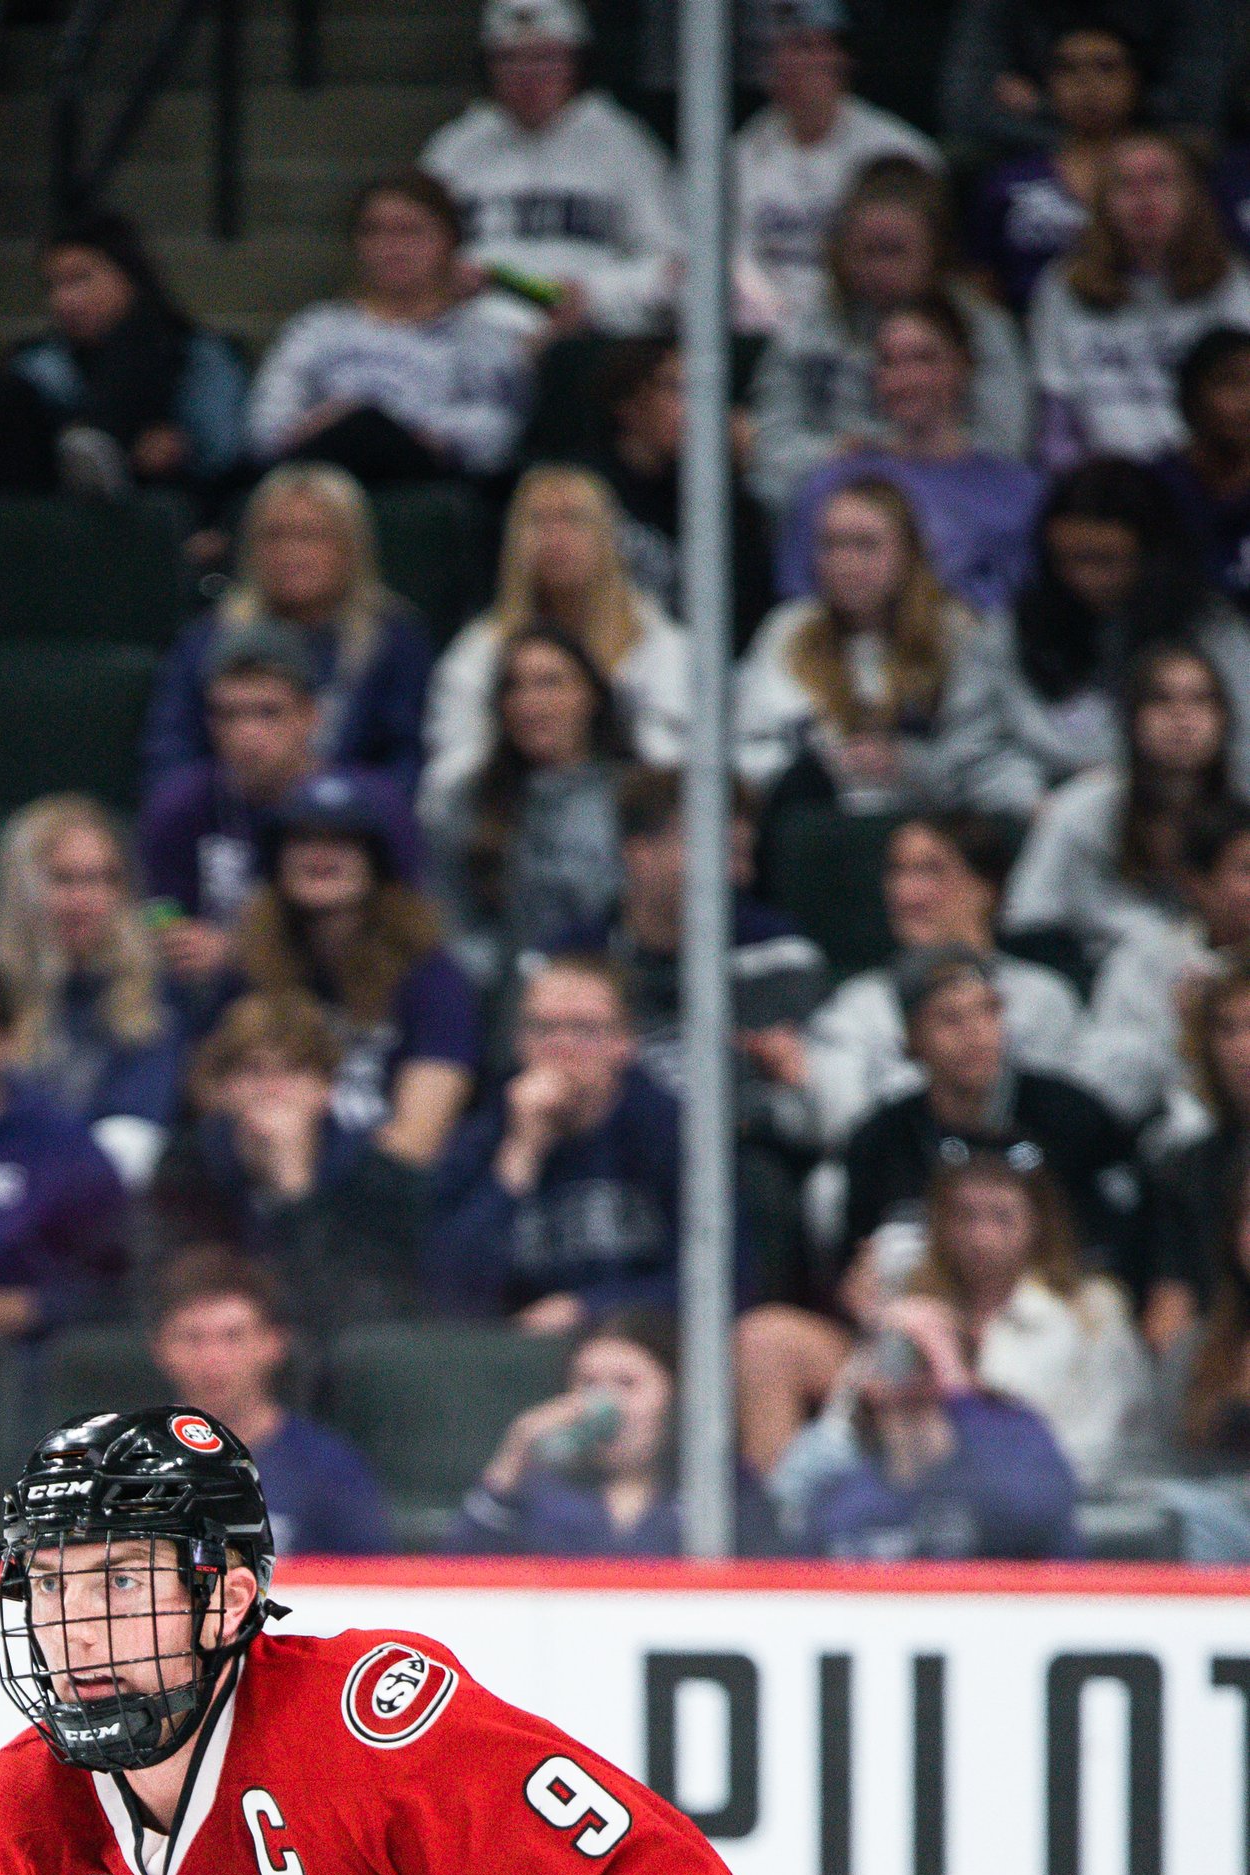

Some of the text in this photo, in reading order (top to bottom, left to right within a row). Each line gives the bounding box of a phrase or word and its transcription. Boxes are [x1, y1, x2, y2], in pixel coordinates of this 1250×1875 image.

[27, 1480, 94, 1500] CCM
[65, 1722, 121, 1742] CCM
[523, 1754, 633, 1860] 9
